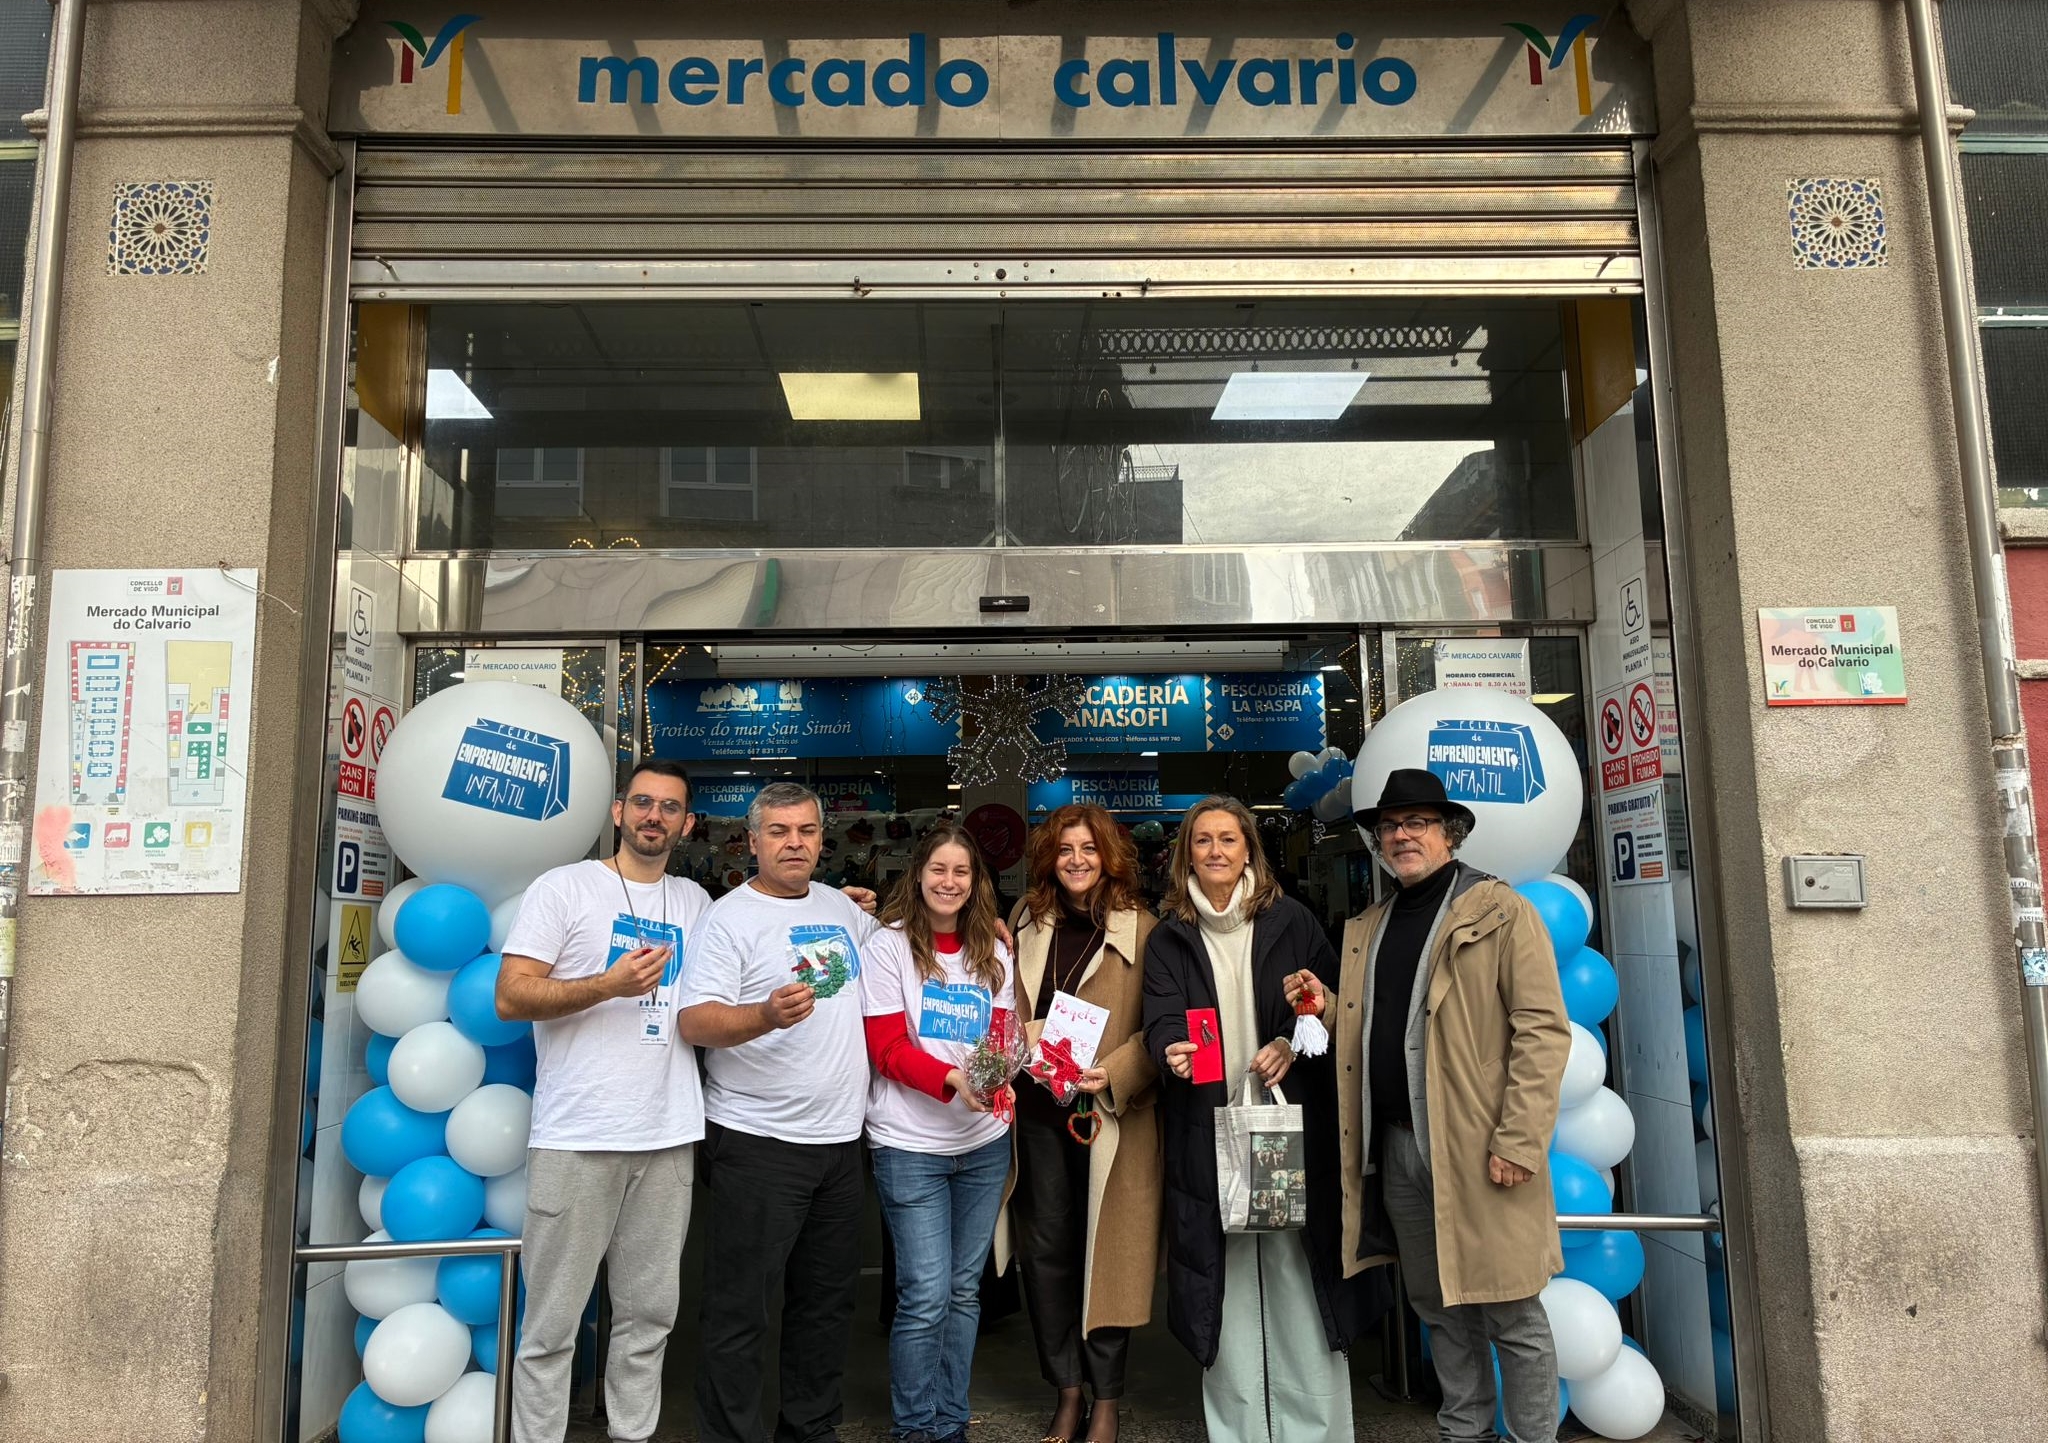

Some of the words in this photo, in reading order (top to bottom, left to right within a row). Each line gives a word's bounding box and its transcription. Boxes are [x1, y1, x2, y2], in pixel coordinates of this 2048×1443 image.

[577, 32, 990, 107] mercado
[1053, 32, 1418, 107] calvario
[87, 605, 148, 618] Mercado
[151, 604, 219, 619] Municipal
[113, 618, 131, 630] do
[135, 618, 192, 630] Calvario
[1451, 652, 1487, 660] MERCADO
[1771, 644, 1828, 656] Mercado
[1831, 643, 1894, 657] Municipal
[1625, 659, 1643, 674] PLANTA
[1798, 656, 1815, 668] do
[1818, 656, 1870, 668] Calvario
[346, 667, 364, 682] PLANTA
[1221, 680, 1313, 697] PESCADERÍA
[1231, 700, 1251, 712] LA
[1254, 699, 1303, 712] RASPA
[1063, 707, 1168, 728] ANASOFI
[710, 720, 730, 738] do
[734, 724, 765, 737] mar
[767, 721, 799, 738] San
[802, 720, 853, 737] Simón
[1459, 720, 1501, 732] FEIRA
[497, 724, 539, 744] FEIRA
[1471, 732, 1482, 743] de
[505, 739, 517, 751] de
[1631, 748, 1659, 767] PROHIBIDO
[339, 764, 363, 780] CANS
[1605, 759, 1626, 775] CANS
[1636, 764, 1658, 780] FUMAR
[341, 778, 360, 793] NON
[699, 782, 756, 793] PESCADERÍA
[1071, 777, 1159, 792] PESCADERÍA
[1445, 767, 1507, 799] INFANTIL
[1608, 773, 1625, 787] NON
[464, 773, 525, 810] INFANTIL
[712, 794, 745, 803] LAURA
[1607, 800, 1628, 816] PARKING
[1627, 795, 1651, 812] GRATUITO
[337, 806, 359, 824] PARKING
[1617, 837, 1630, 876] P
[340, 846, 356, 888] P
